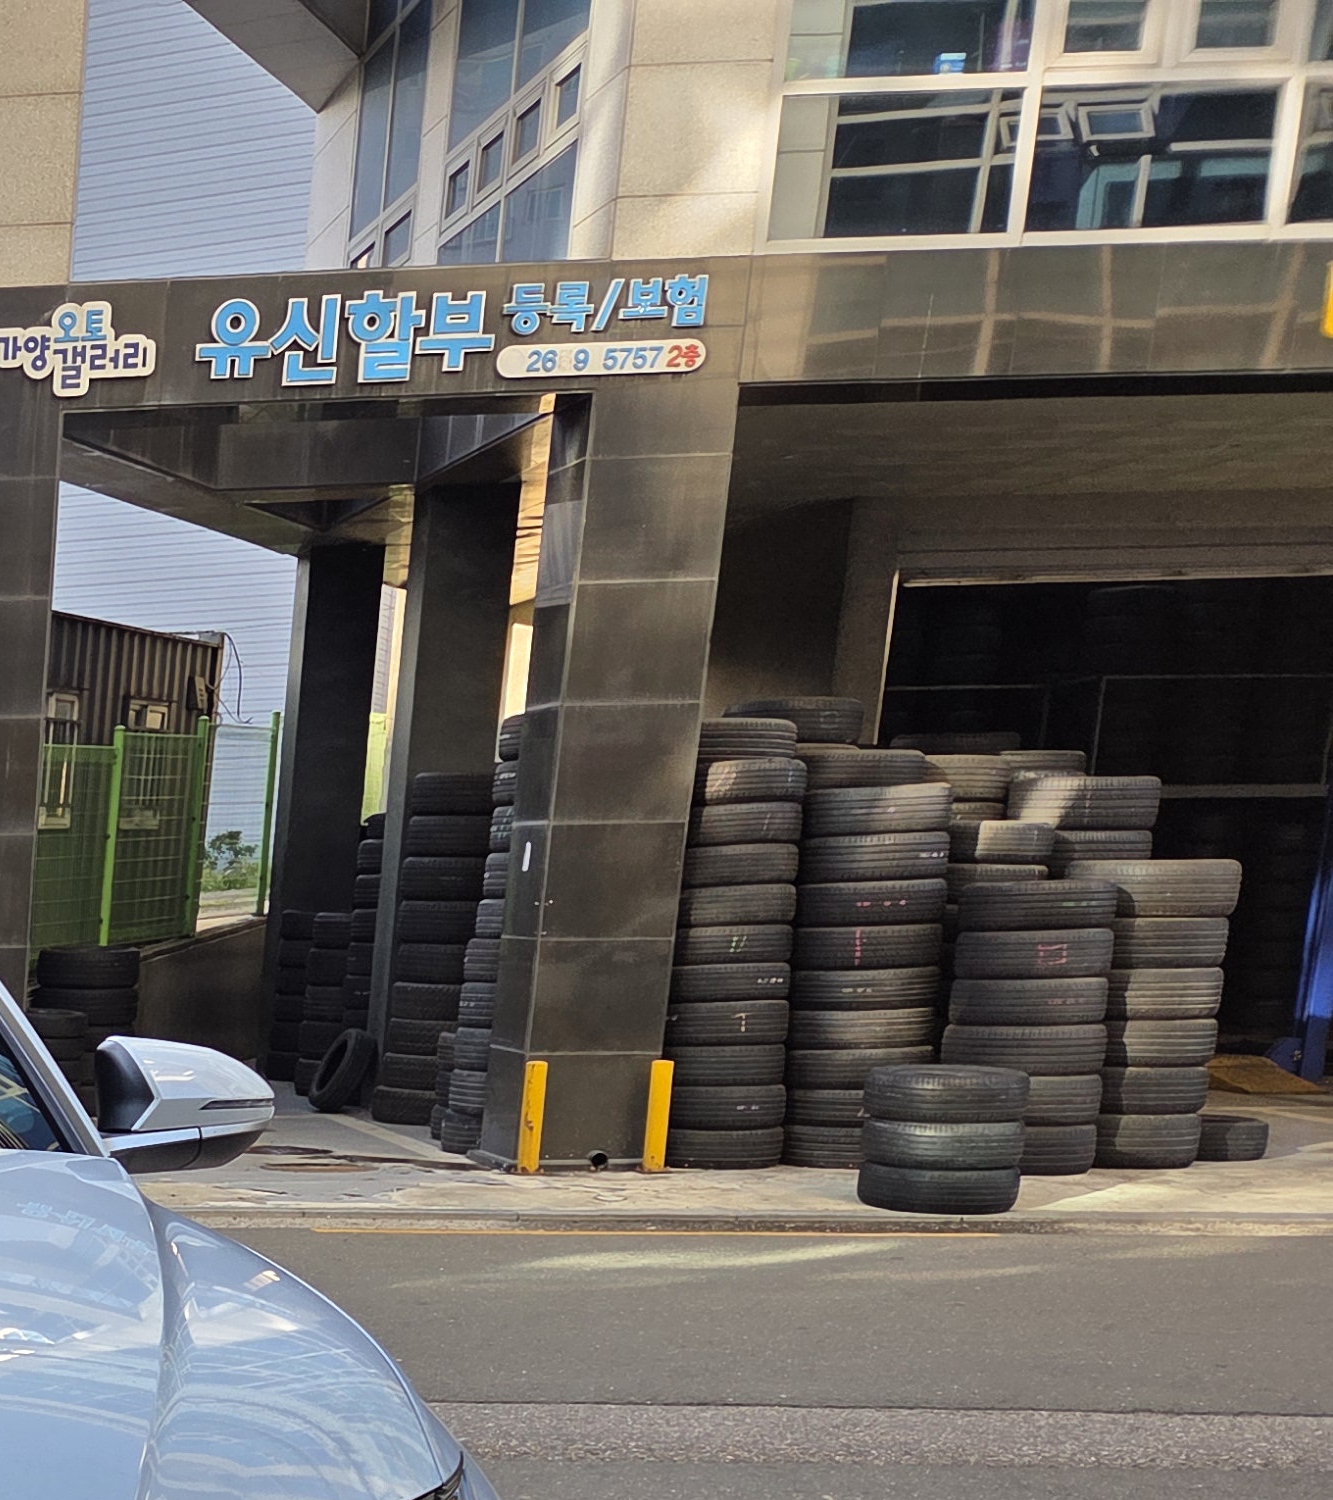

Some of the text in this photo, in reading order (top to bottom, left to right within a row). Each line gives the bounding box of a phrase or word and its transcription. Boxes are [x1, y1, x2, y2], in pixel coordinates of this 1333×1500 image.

[54, 309, 107, 343] 오토
[503, 274, 709, 335] 등록/보험
[195, 290, 495, 386] 유신할부
[602, 345, 664, 370] 5757
